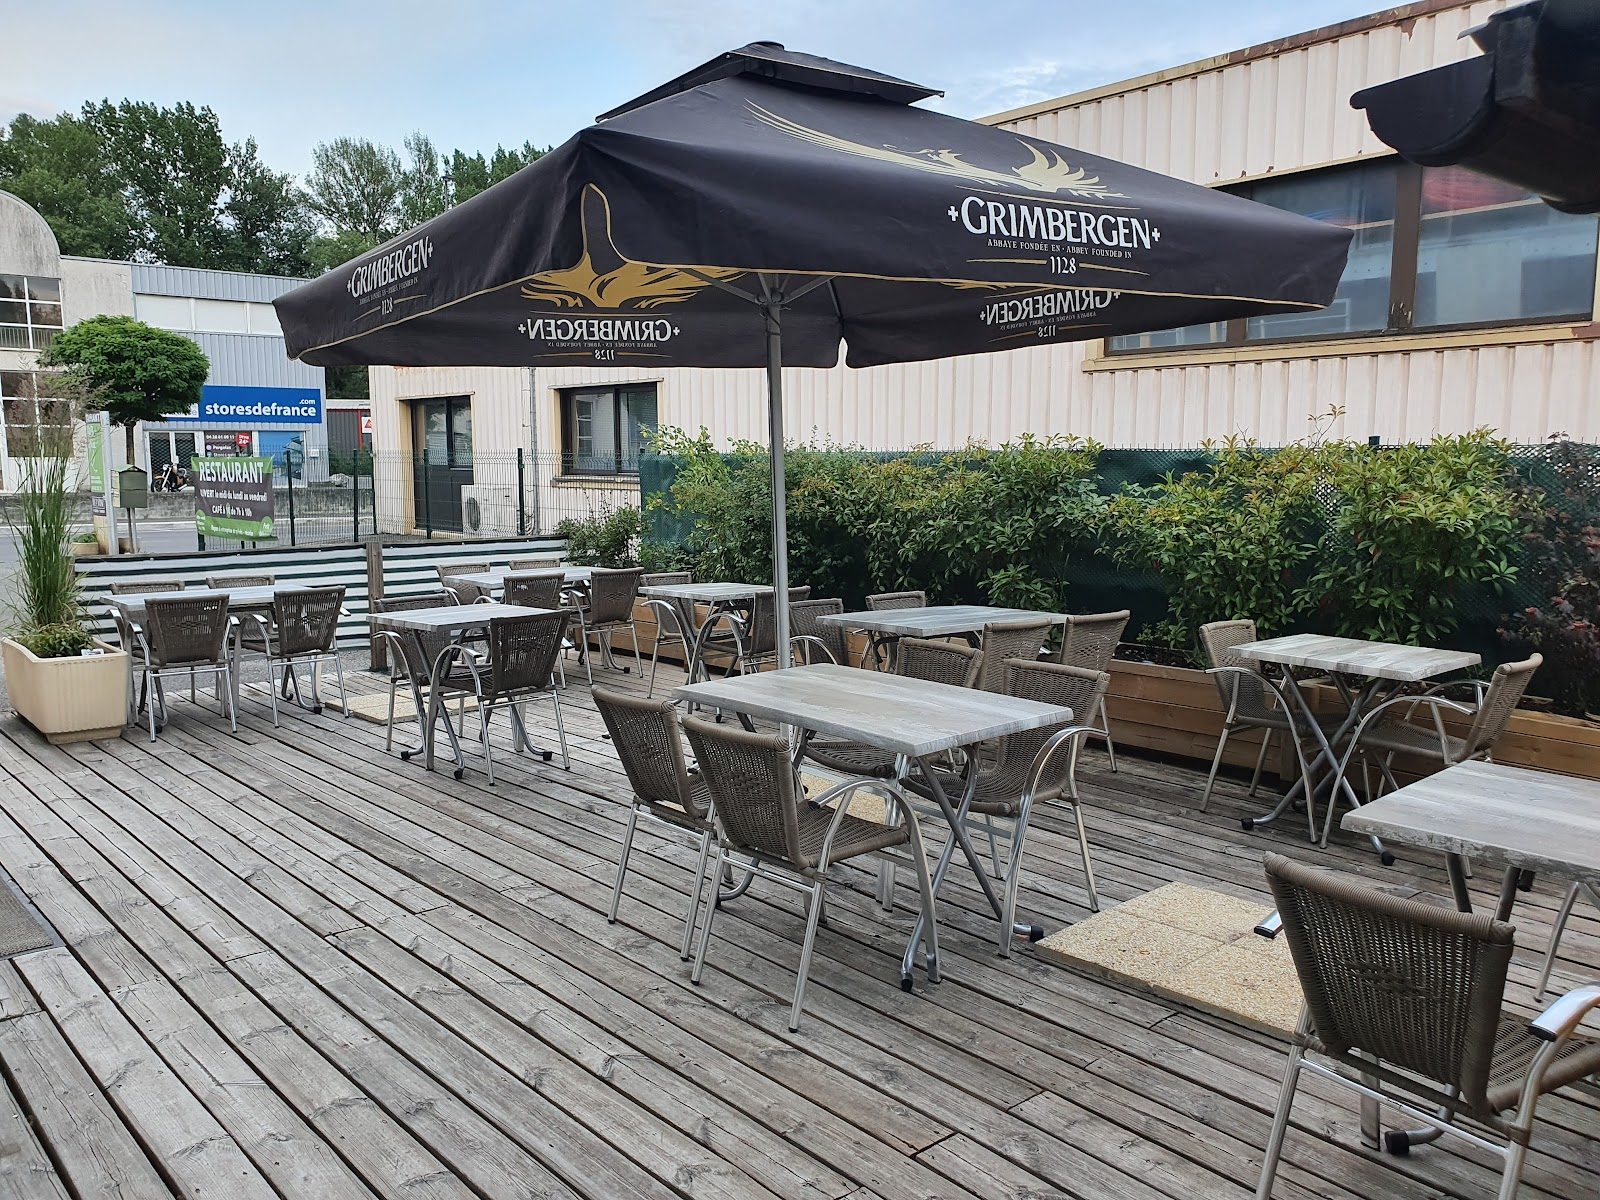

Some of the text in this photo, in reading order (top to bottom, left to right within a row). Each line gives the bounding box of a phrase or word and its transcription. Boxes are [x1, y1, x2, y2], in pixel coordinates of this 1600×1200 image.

[961, 196, 1151, 249] GRIMBERGEN
[988, 239, 1017, 249] ABBAYE
[1020, 241, 1048, 252] FONDÉE
[1066, 246, 1088, 255] ABBEY
[1091, 248, 1123, 258] FOUNDED
[1124, 251, 1132, 259] IN
[351, 236, 428, 298] GRIMBERGEN
[1050, 256, 1077, 274] 1128
[381, 297, 393, 315] 1128
[205, 402, 317, 417] storesdefrance
[199, 461, 264, 484] RESTAURANT
